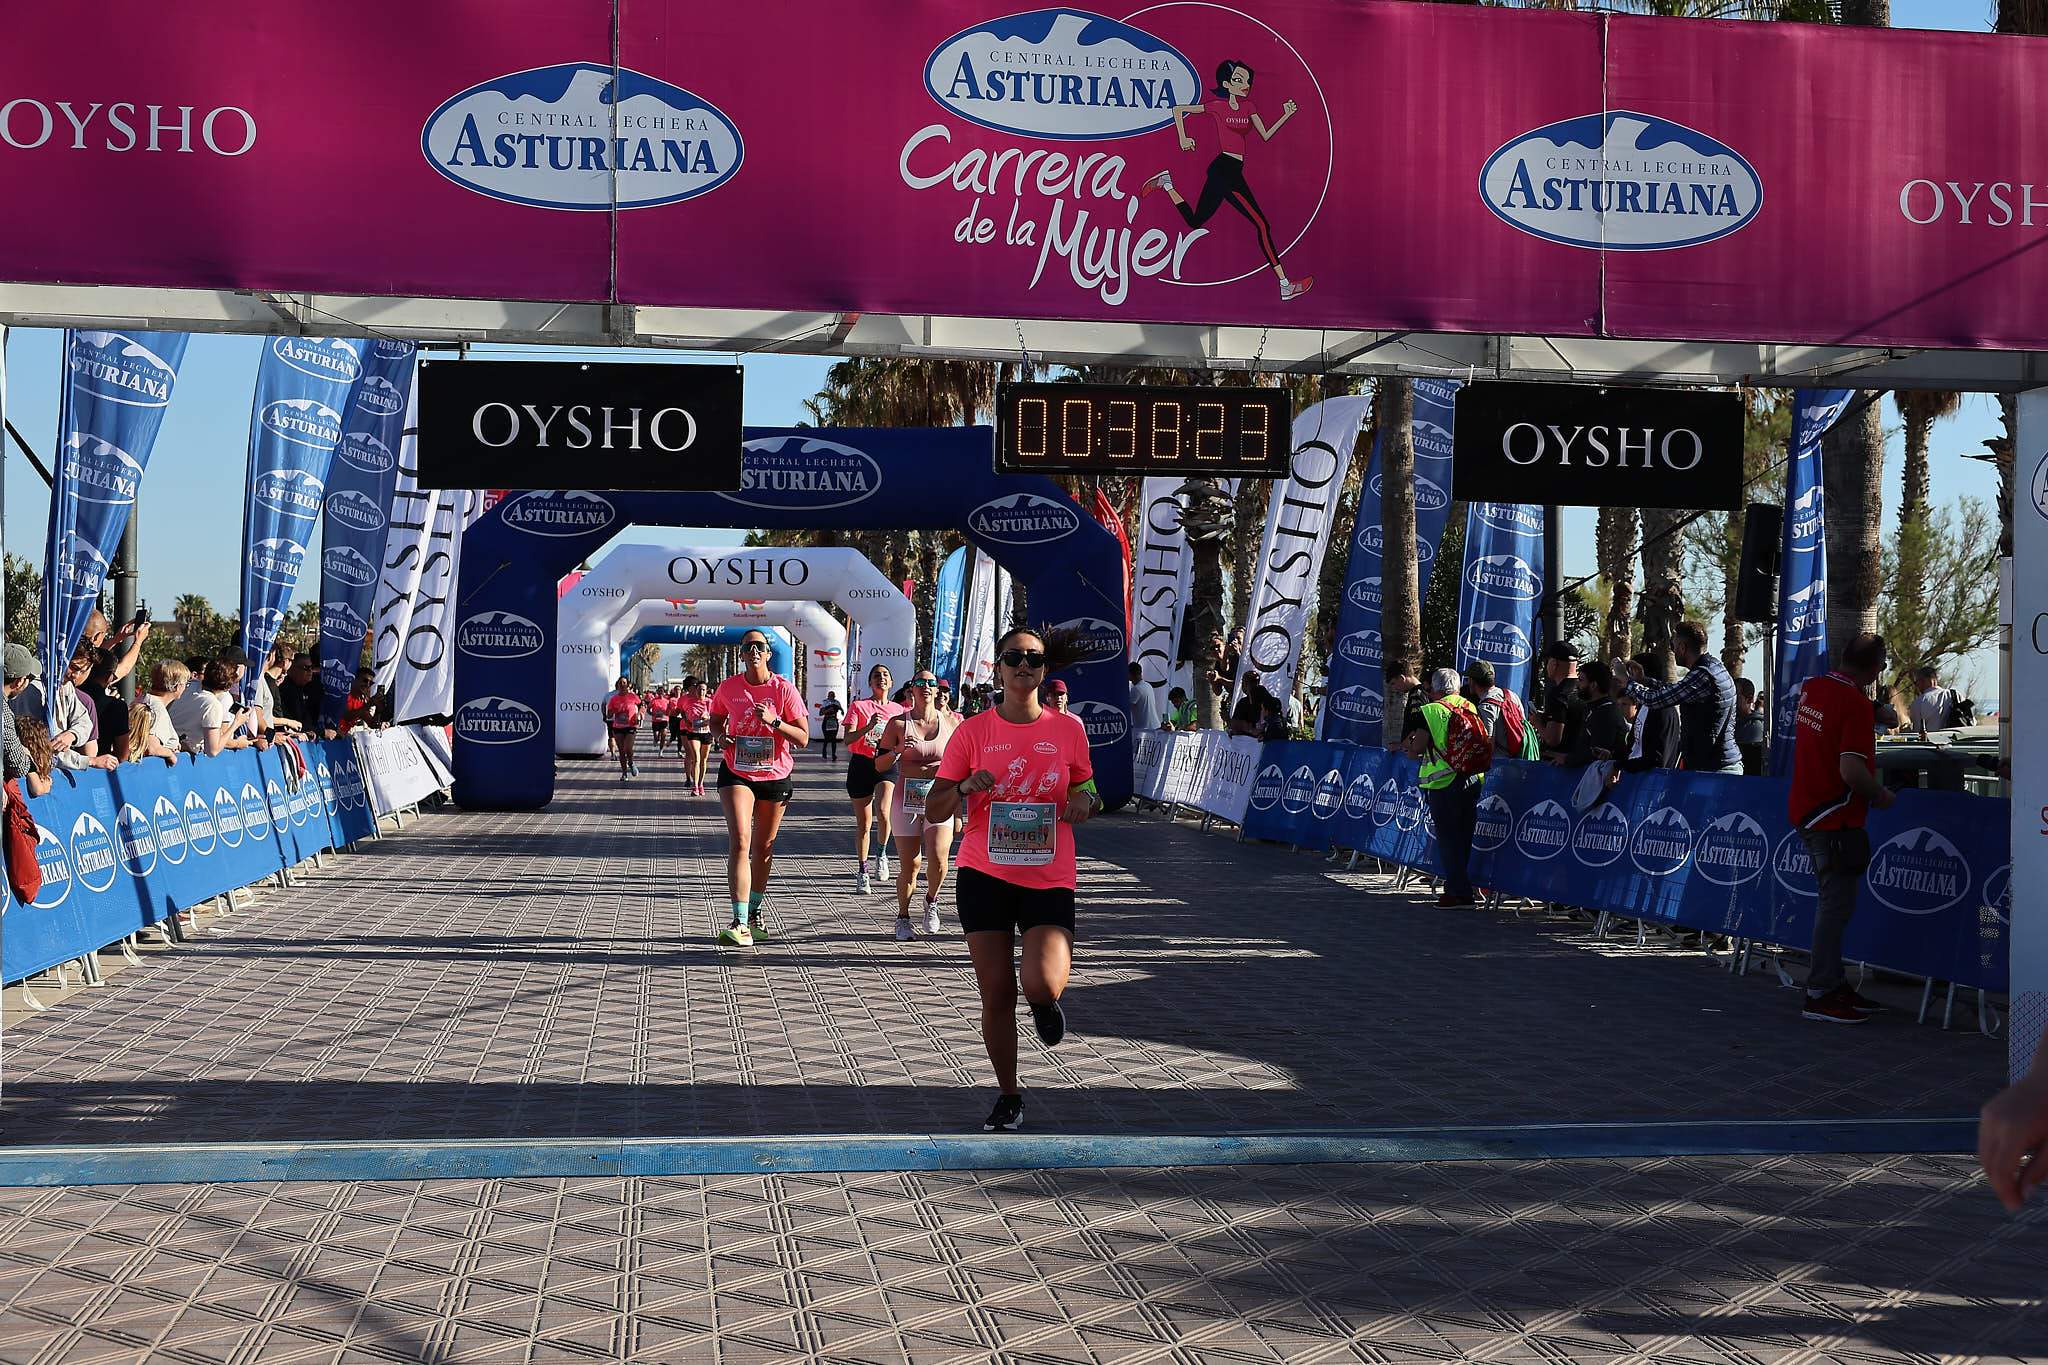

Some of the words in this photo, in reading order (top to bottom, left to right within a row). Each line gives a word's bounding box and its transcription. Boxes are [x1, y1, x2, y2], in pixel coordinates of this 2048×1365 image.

[990, 50, 1074, 66] CENTRAL
[1085, 56, 1172, 71] LECHERA
[946, 51, 1177, 109] ASTURIANA
[0, 98, 257, 156] OYSHO
[498, 112, 597, 128] CENTRAL
[447, 112, 719, 174] ASTURIANA
[899, 124, 1125, 199] Carrera
[1546, 157, 1633, 173] CENTRAL
[1643, 160, 1732, 177] LECHERA
[1502, 158, 1740, 216] ASTURIANA
[954, 204, 996, 244] de
[1005, 199, 1036, 246] la
[1028, 195, 1209, 305] Mujer
[280, 340, 355, 380] ASTURIAN
[74, 357, 168, 400] STURIANA
[268, 407, 338, 443] ASTURIAN
[472, 402, 697, 452] OYSHO
[1018, 399, 1269, 460] 00:38:23
[1502, 423, 1702, 471] OYSHO
[744, 457, 800, 466] CENTRAL
[806, 458, 862, 467] LECHERA
[742, 469, 868, 492] STURIANA
[330, 499, 379, 526] ASTURIANA
[508, 504, 606, 524] ASTURIANA
[977, 514, 1073, 532] ASTURIANA
[251, 553, 298, 577] ASTURIA
[324, 555, 370, 582] ASTURIANA
[1250, 441, 1338, 672] OYSHO
[667, 557, 809, 586] OYSHO
[405, 502, 454, 671] OYSH
[582, 587, 625, 598] OYSHO
[848, 589, 890, 599] OYSHO
[1137, 496, 1184, 689] OYSHO
[461, 628, 538, 647] ASTURIANA
[562, 644, 602, 654] OYSHO
[1342, 640, 1383, 659] ASTURIA
[870, 647, 909, 657] OYSHO
[560, 702, 600, 712] OYSHO
[1800, 704, 1824, 721] SPEAKER
[458, 713, 535, 733] ASTURIANA
[1087, 722, 1123, 735] RIANA
[984, 743, 1012, 753] OYSHO
[1213, 747, 1251, 787] OYSHO
[1474, 821, 1507, 839] STURIANA
[1518, 820, 1565, 846] ASTURIANA
[1575, 824, 1622, 852] ASTURIANA
[1633, 829, 1686, 859] ASTURIANA
[1698, 836, 1760, 868] ASTURIANA
[75, 846, 115, 875] ASTURIANA
[1872, 854, 1957, 897] ASTURIANA
